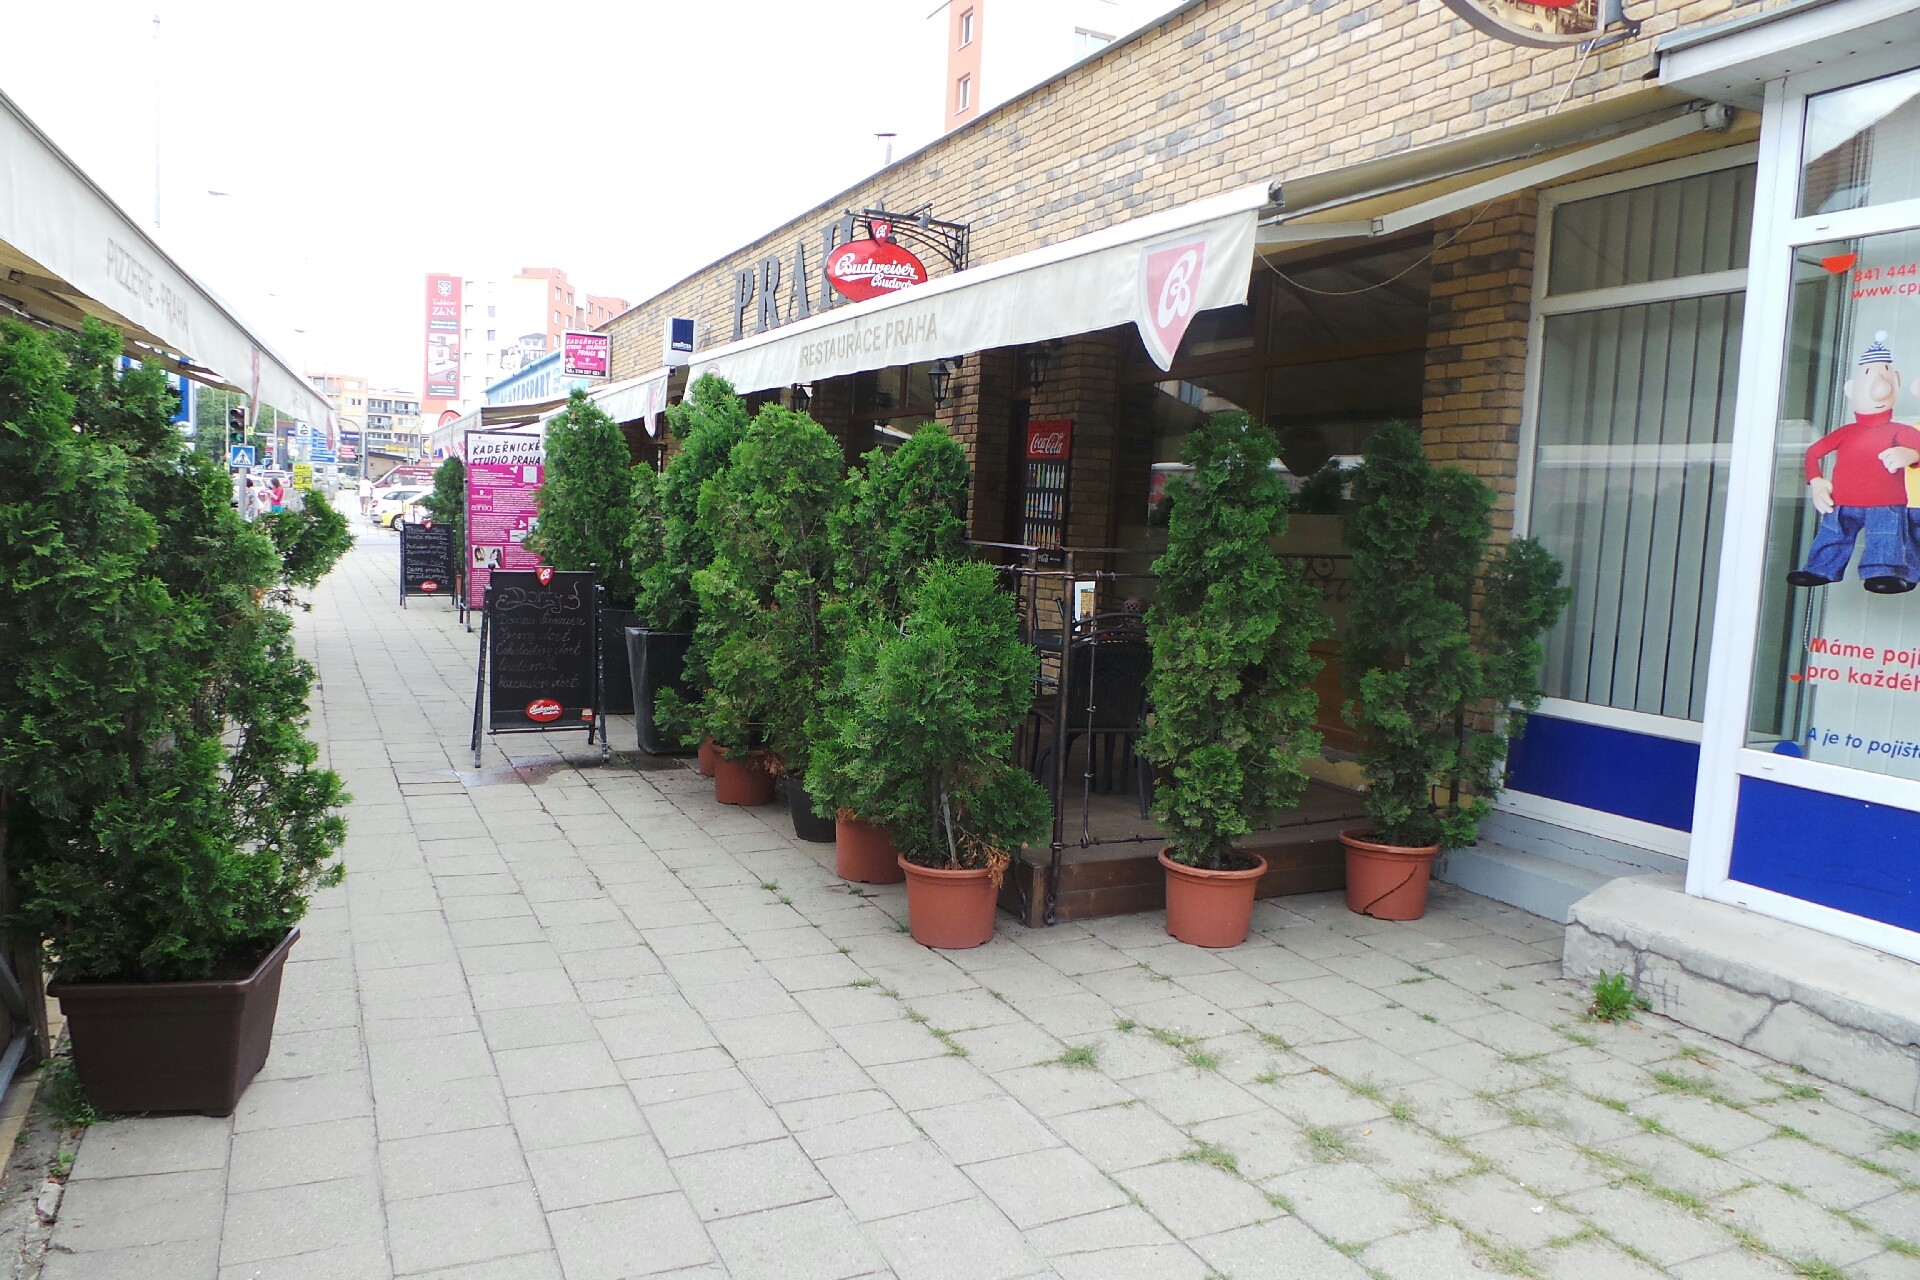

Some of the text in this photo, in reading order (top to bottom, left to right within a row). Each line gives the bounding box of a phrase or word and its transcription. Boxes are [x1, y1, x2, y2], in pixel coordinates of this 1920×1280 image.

[834, 252, 917, 280] Budweiser
[1854, 263, 1917, 283] 841 444
[107, 237, 154, 309] PIZZERIE
[161, 283, 189, 335] PRAHA
[1852, 282, 1920, 299] www.cp
[801, 313, 938, 367] RESTAURACE PRAHA
[472, 439, 541, 456] KADEŘNICKÉ
[471, 454, 541, 466] STUDIO PRAHA
[1810, 638, 1875, 660] Máme
[1807, 665, 1840, 682] pro
[1807, 727, 1920, 758] A je to pojišt
